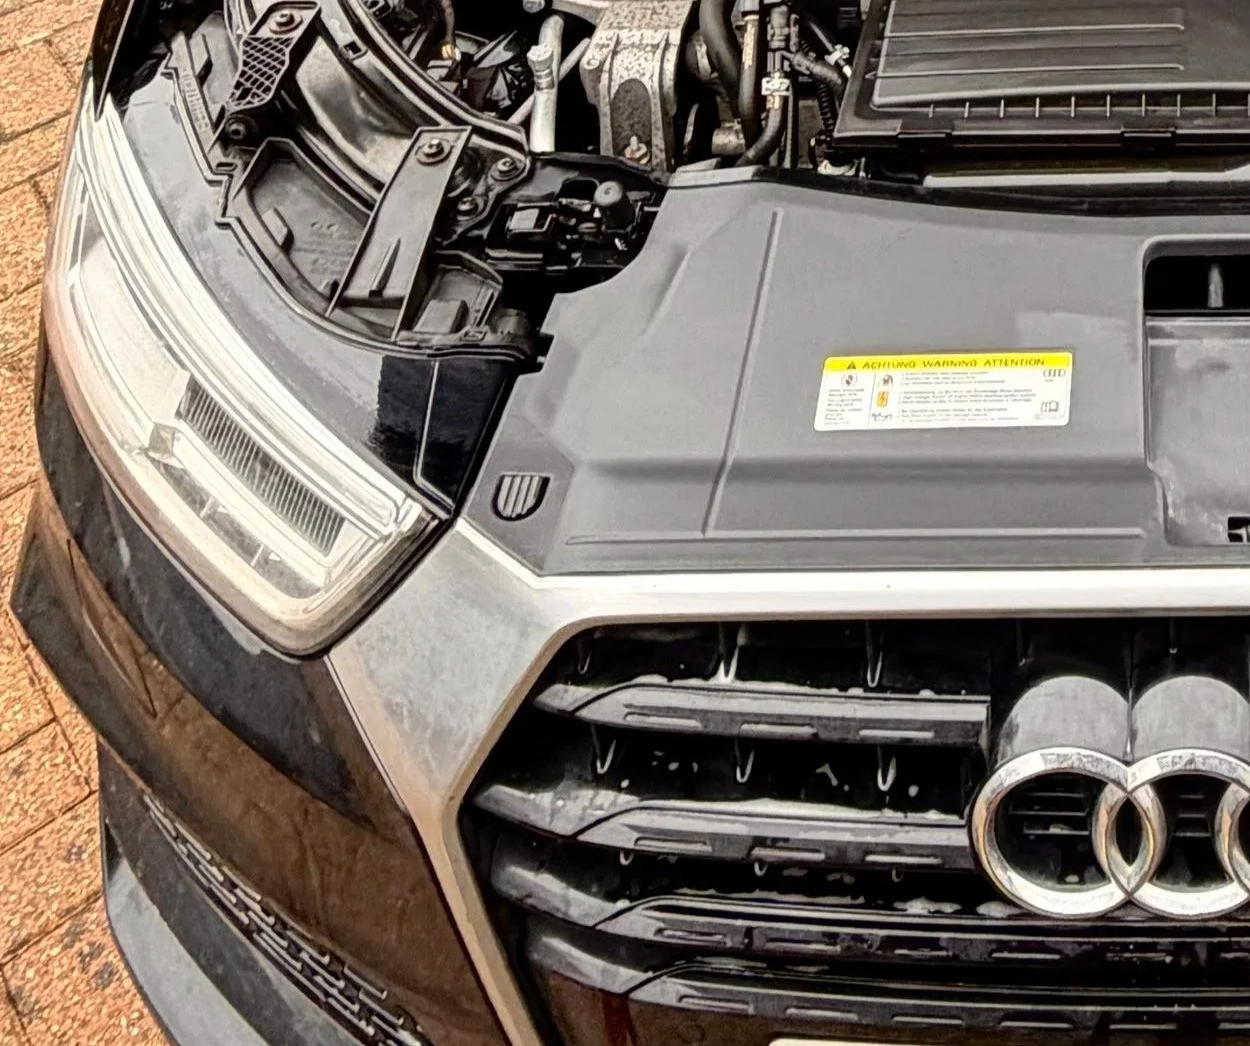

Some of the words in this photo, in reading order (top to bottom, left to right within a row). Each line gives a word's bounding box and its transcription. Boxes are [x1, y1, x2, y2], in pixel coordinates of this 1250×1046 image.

[862, 360, 917, 370] ACHTUNG
[922, 359, 977, 368] WARNING
[983, 357, 1046, 367] ATTENTION
